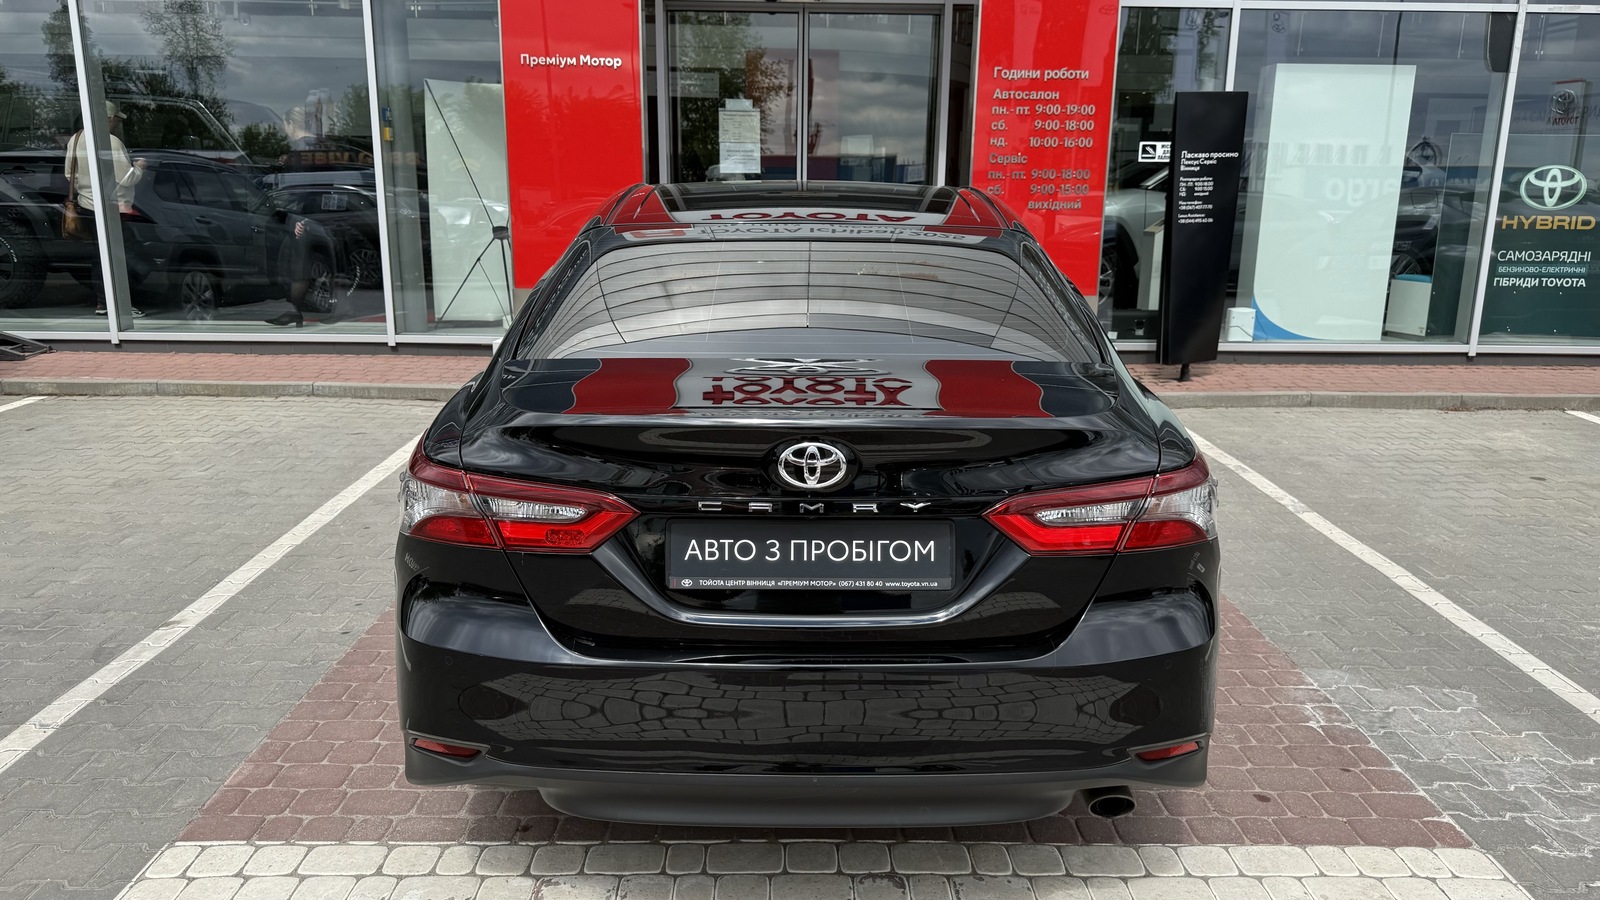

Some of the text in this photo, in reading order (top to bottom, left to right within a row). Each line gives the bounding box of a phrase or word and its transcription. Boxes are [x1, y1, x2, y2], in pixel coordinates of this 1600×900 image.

[520, 54, 622, 69] Преміум Мотор
[994, 66, 1089, 81] Години роботи
[993, 88, 1060, 100] Автосалон
[1035, 104, 1096, 115] 9:00-19:00
[991, 120, 1094, 131] сб. 9:00-18:00
[990, 137, 1093, 148] нд. 10:00-16:00
[989, 152, 1028, 165] Сервіс
[1031, 169, 1090, 180] 9:00-18:00
[987, 184, 1089, 195] сб. 9:00-15:00
[1028, 199, 1082, 211] вихідний
[1501, 215, 1596, 230] HYBRID
[1498, 250, 1591, 263] САМОЗАРЯДНІ
[1494, 277, 1586, 288] ГІБРИДИ TOYOTA
[698, 501, 931, 513] CAMRY
[684, 539, 756, 561] АВТО
[790, 540, 935, 562] ПРОБІГОМ
